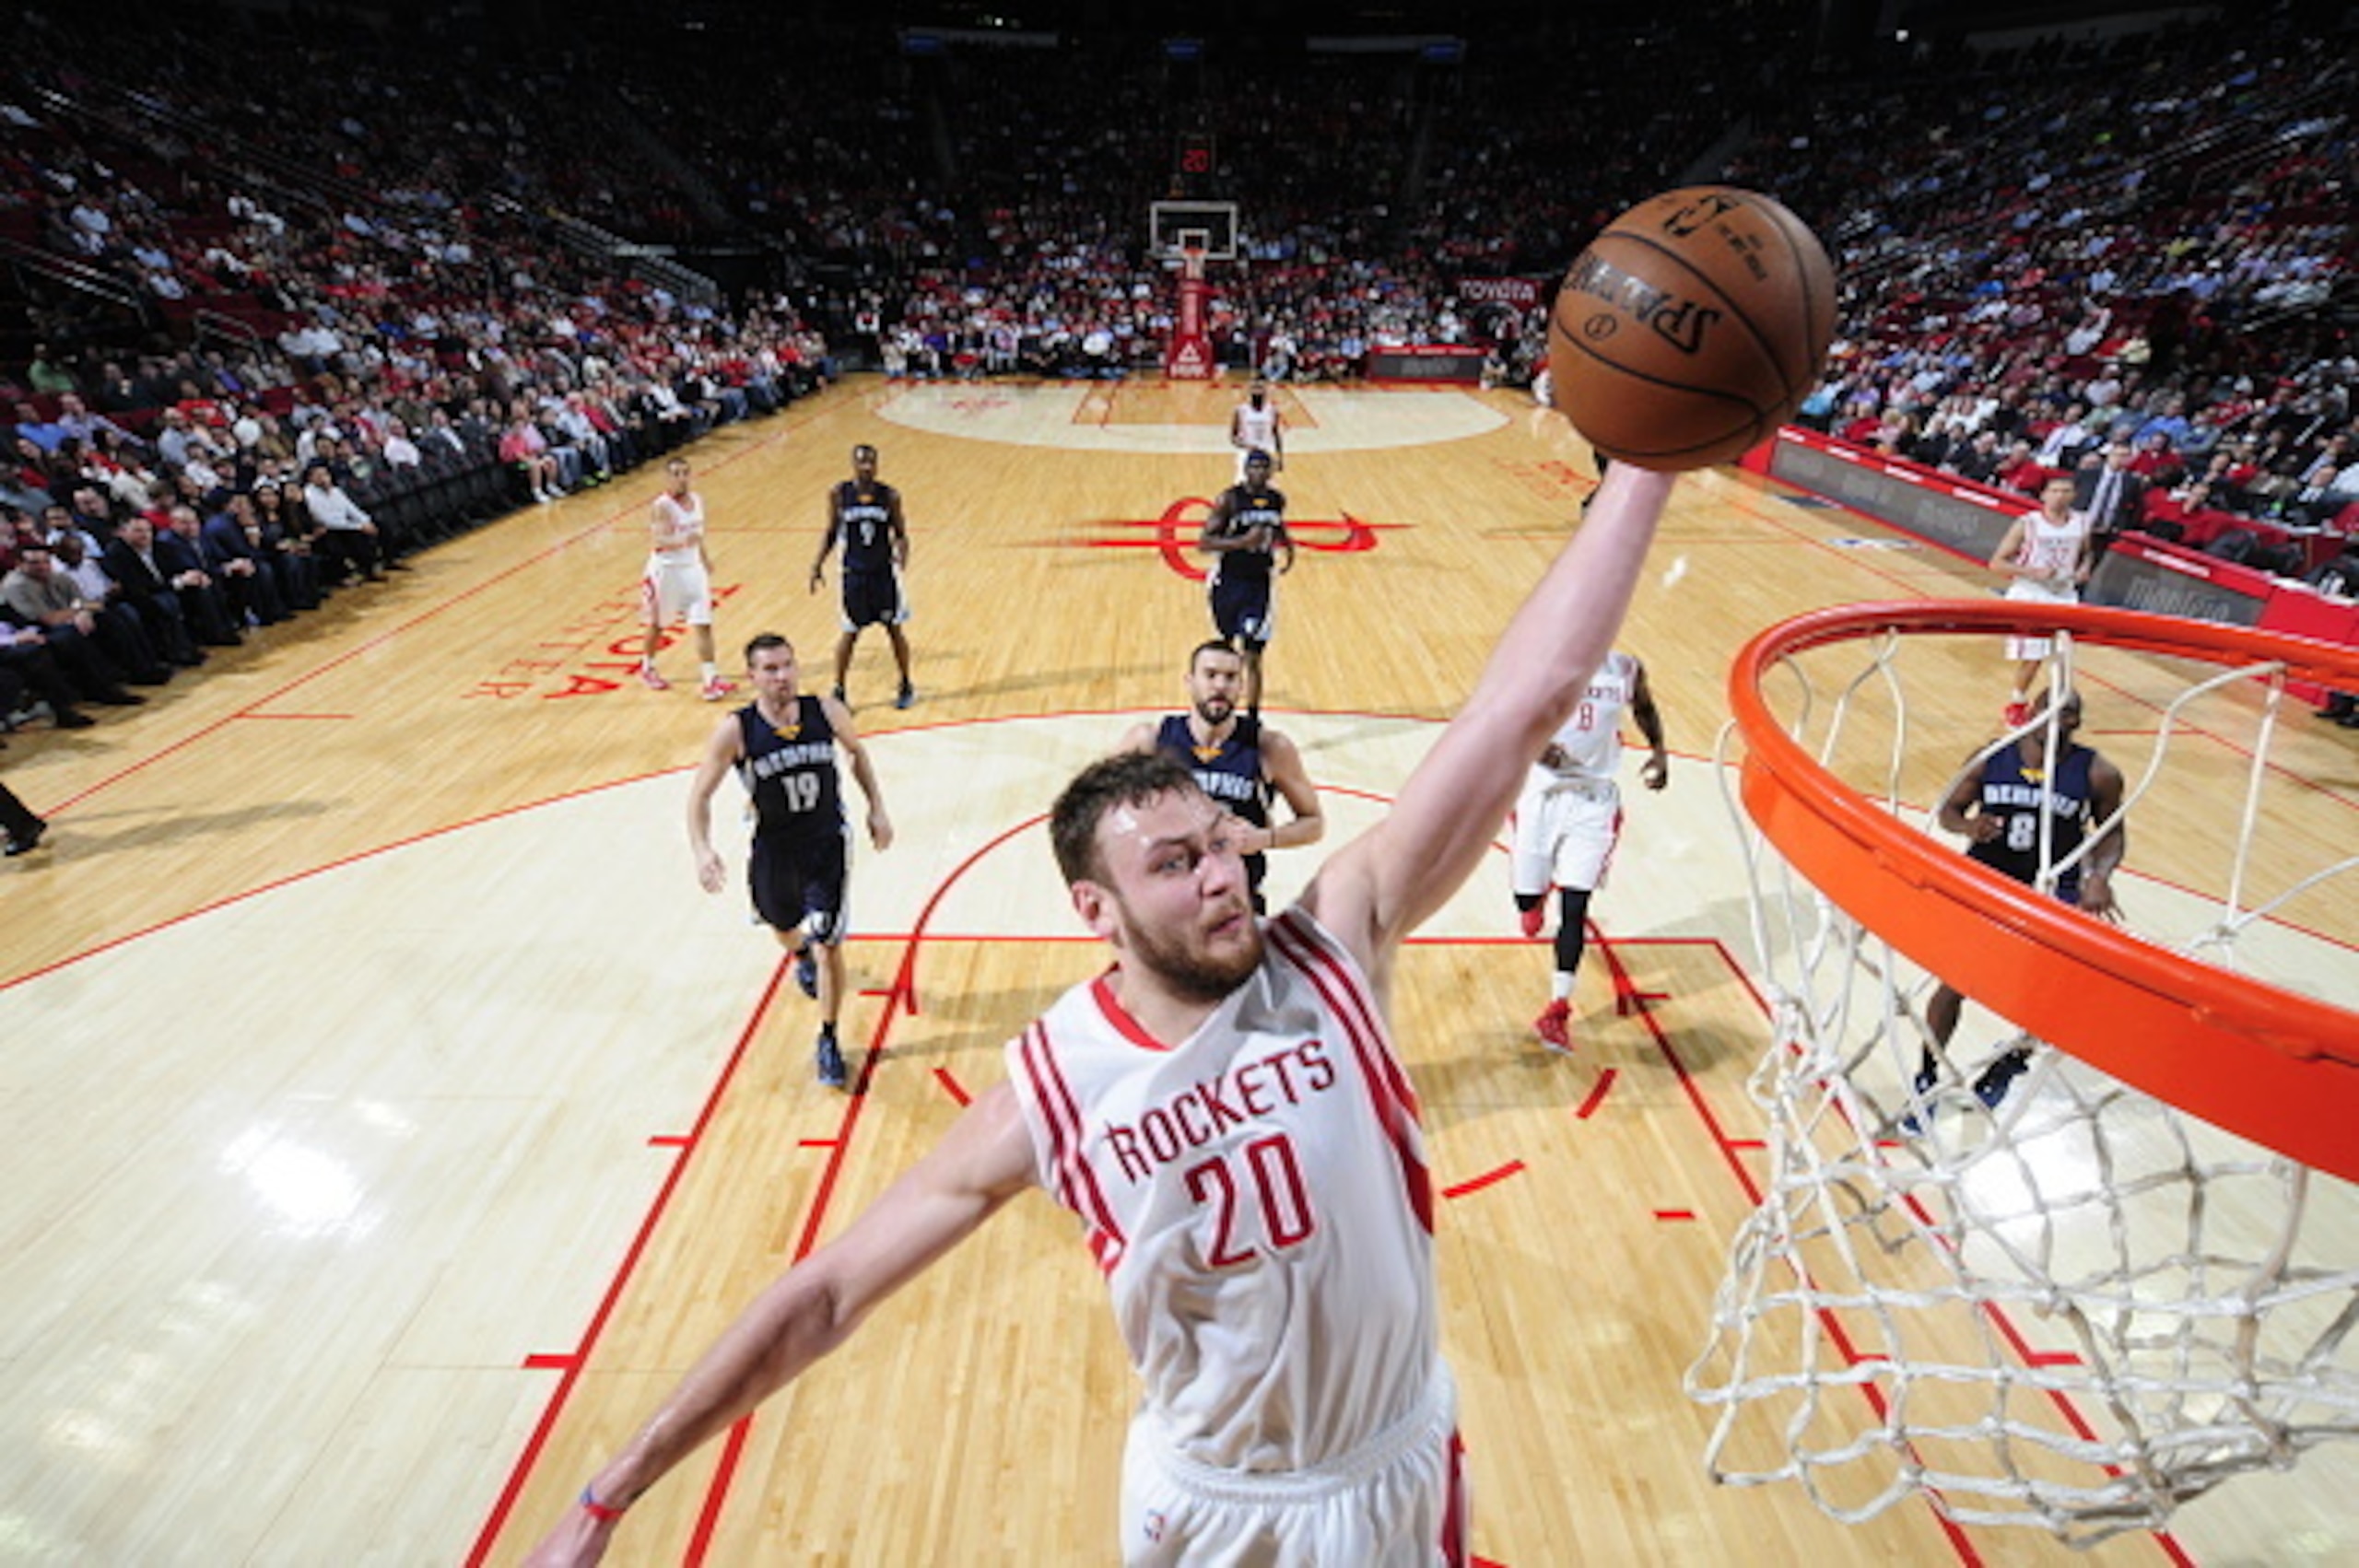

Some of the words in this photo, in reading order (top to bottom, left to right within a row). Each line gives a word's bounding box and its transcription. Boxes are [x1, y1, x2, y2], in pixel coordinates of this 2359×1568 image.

[1459, 280, 1535, 301] TOYOTA
[1579, 703, 1593, 730] 8
[780, 772, 820, 812] 19
[2008, 812, 2036, 851] 8
[1105, 1039, 1335, 1184] ROCKETS
[1185, 1133, 1315, 1266] 20
